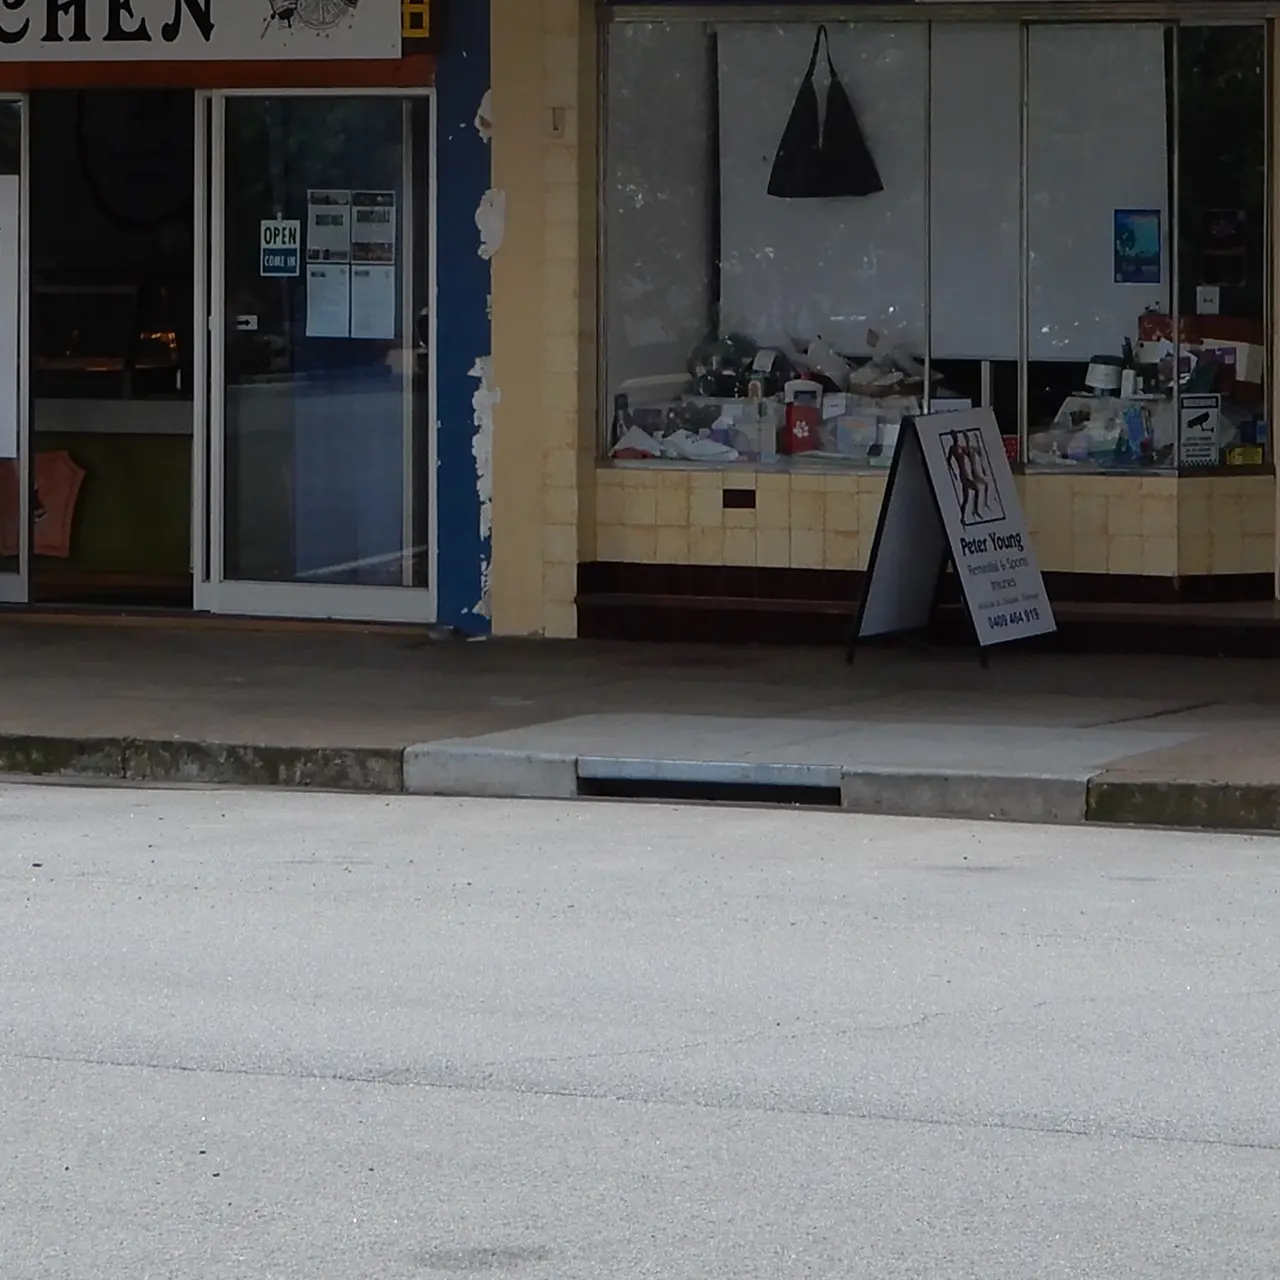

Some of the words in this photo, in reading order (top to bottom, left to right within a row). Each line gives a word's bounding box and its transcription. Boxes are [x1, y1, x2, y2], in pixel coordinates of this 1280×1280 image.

[263, 226, 297, 245] OPEN
[263, 255, 285, 267] COME
[960, 537, 988, 557] Peter
[988, 531, 1024, 552] Young
